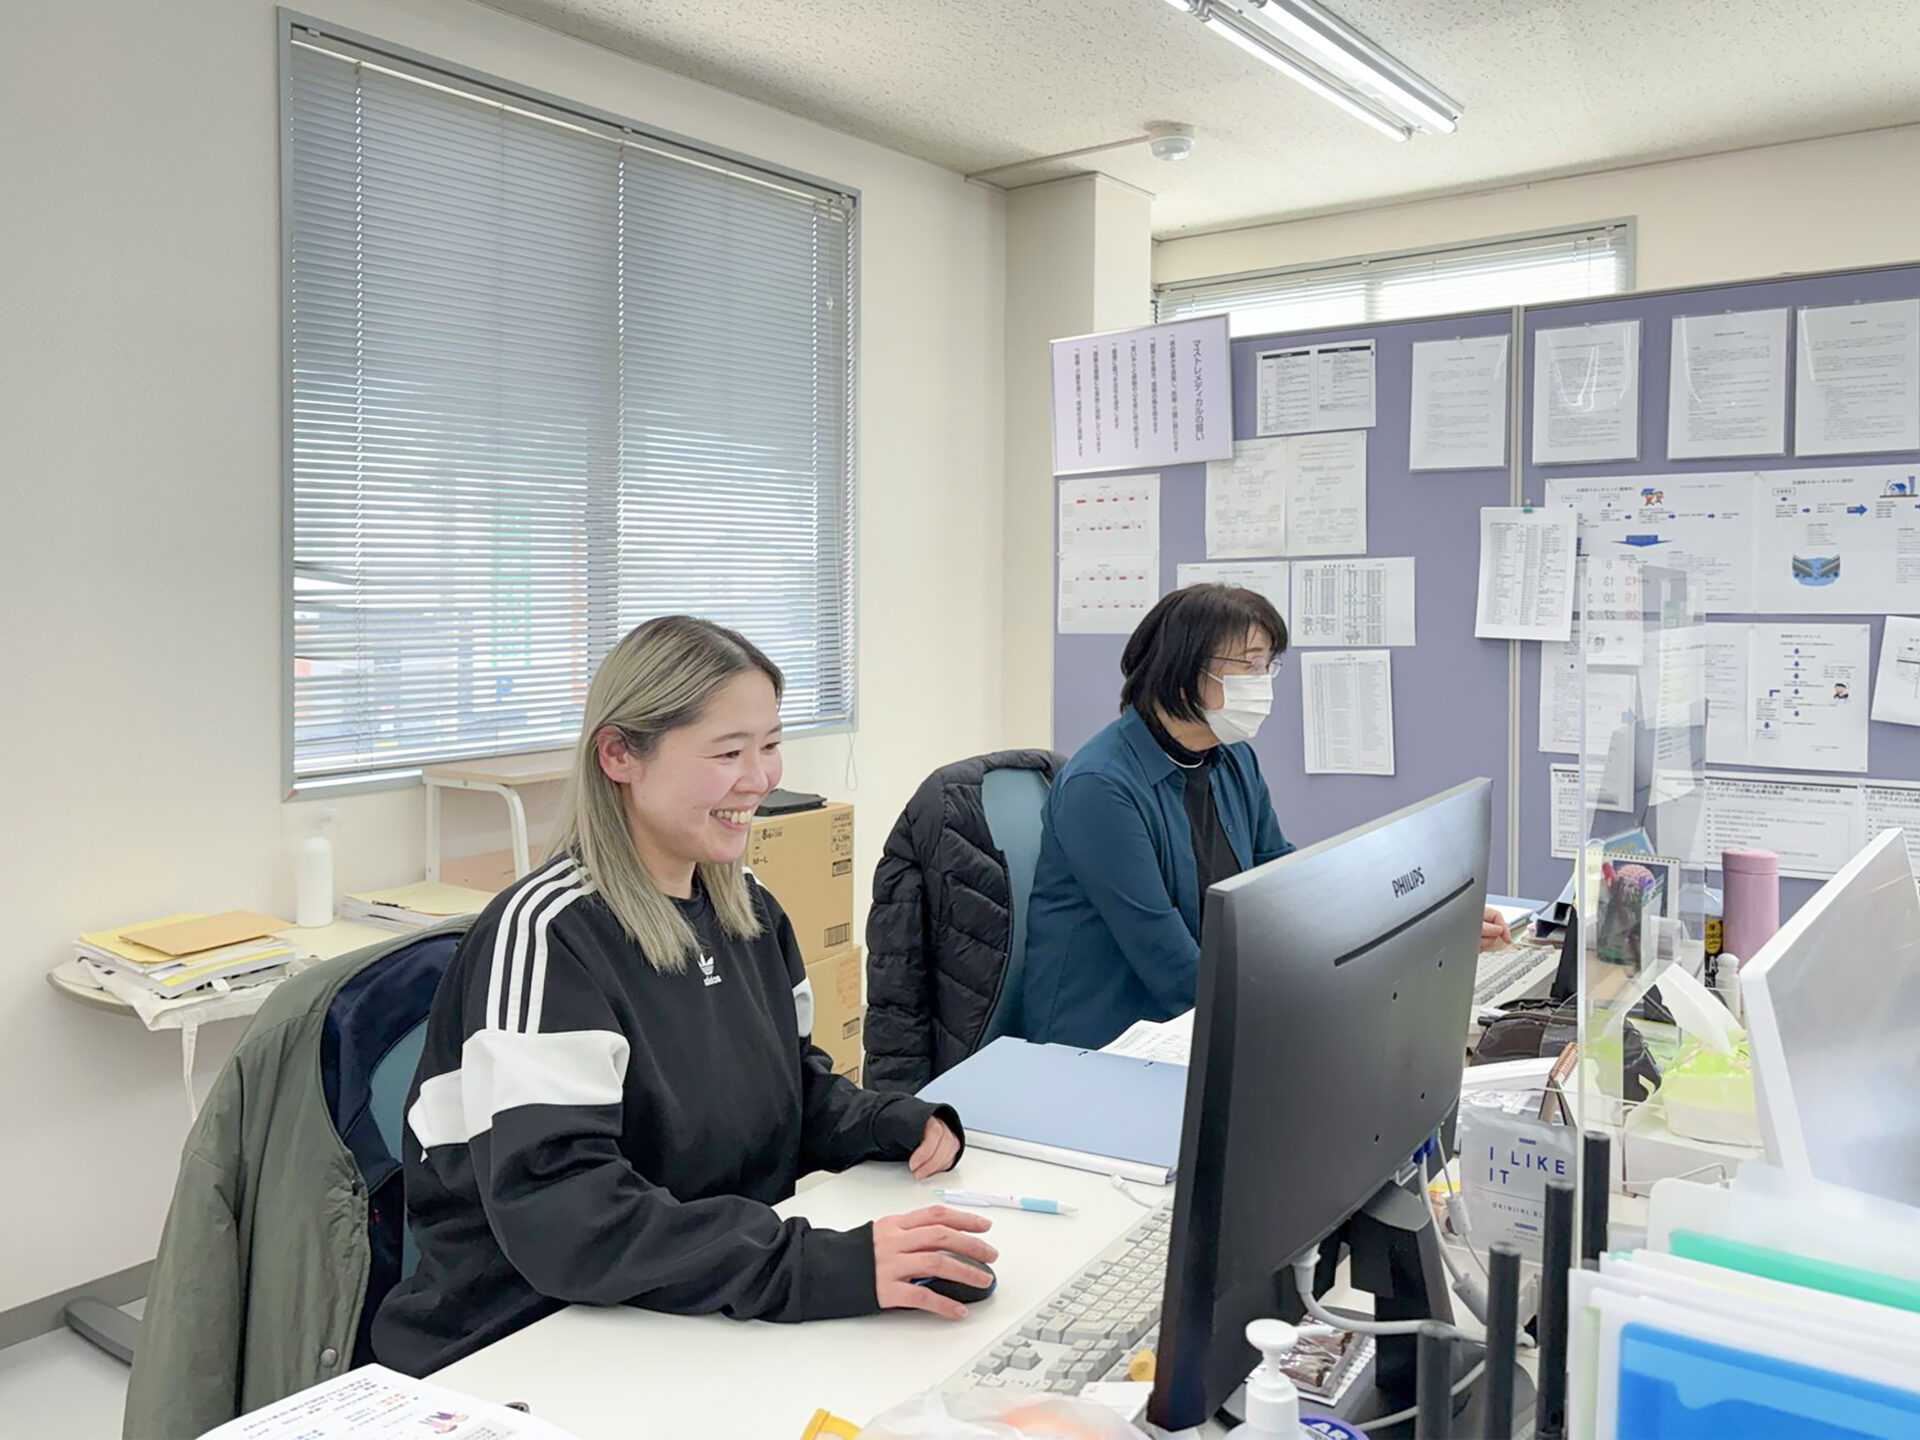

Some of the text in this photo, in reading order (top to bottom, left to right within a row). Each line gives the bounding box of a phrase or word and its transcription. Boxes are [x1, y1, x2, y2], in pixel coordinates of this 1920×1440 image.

[1391, 866, 1426, 898] PHILIPS
[1489, 1145, 1566, 1175] I LIKE
[1489, 1168, 1510, 1185] IT
